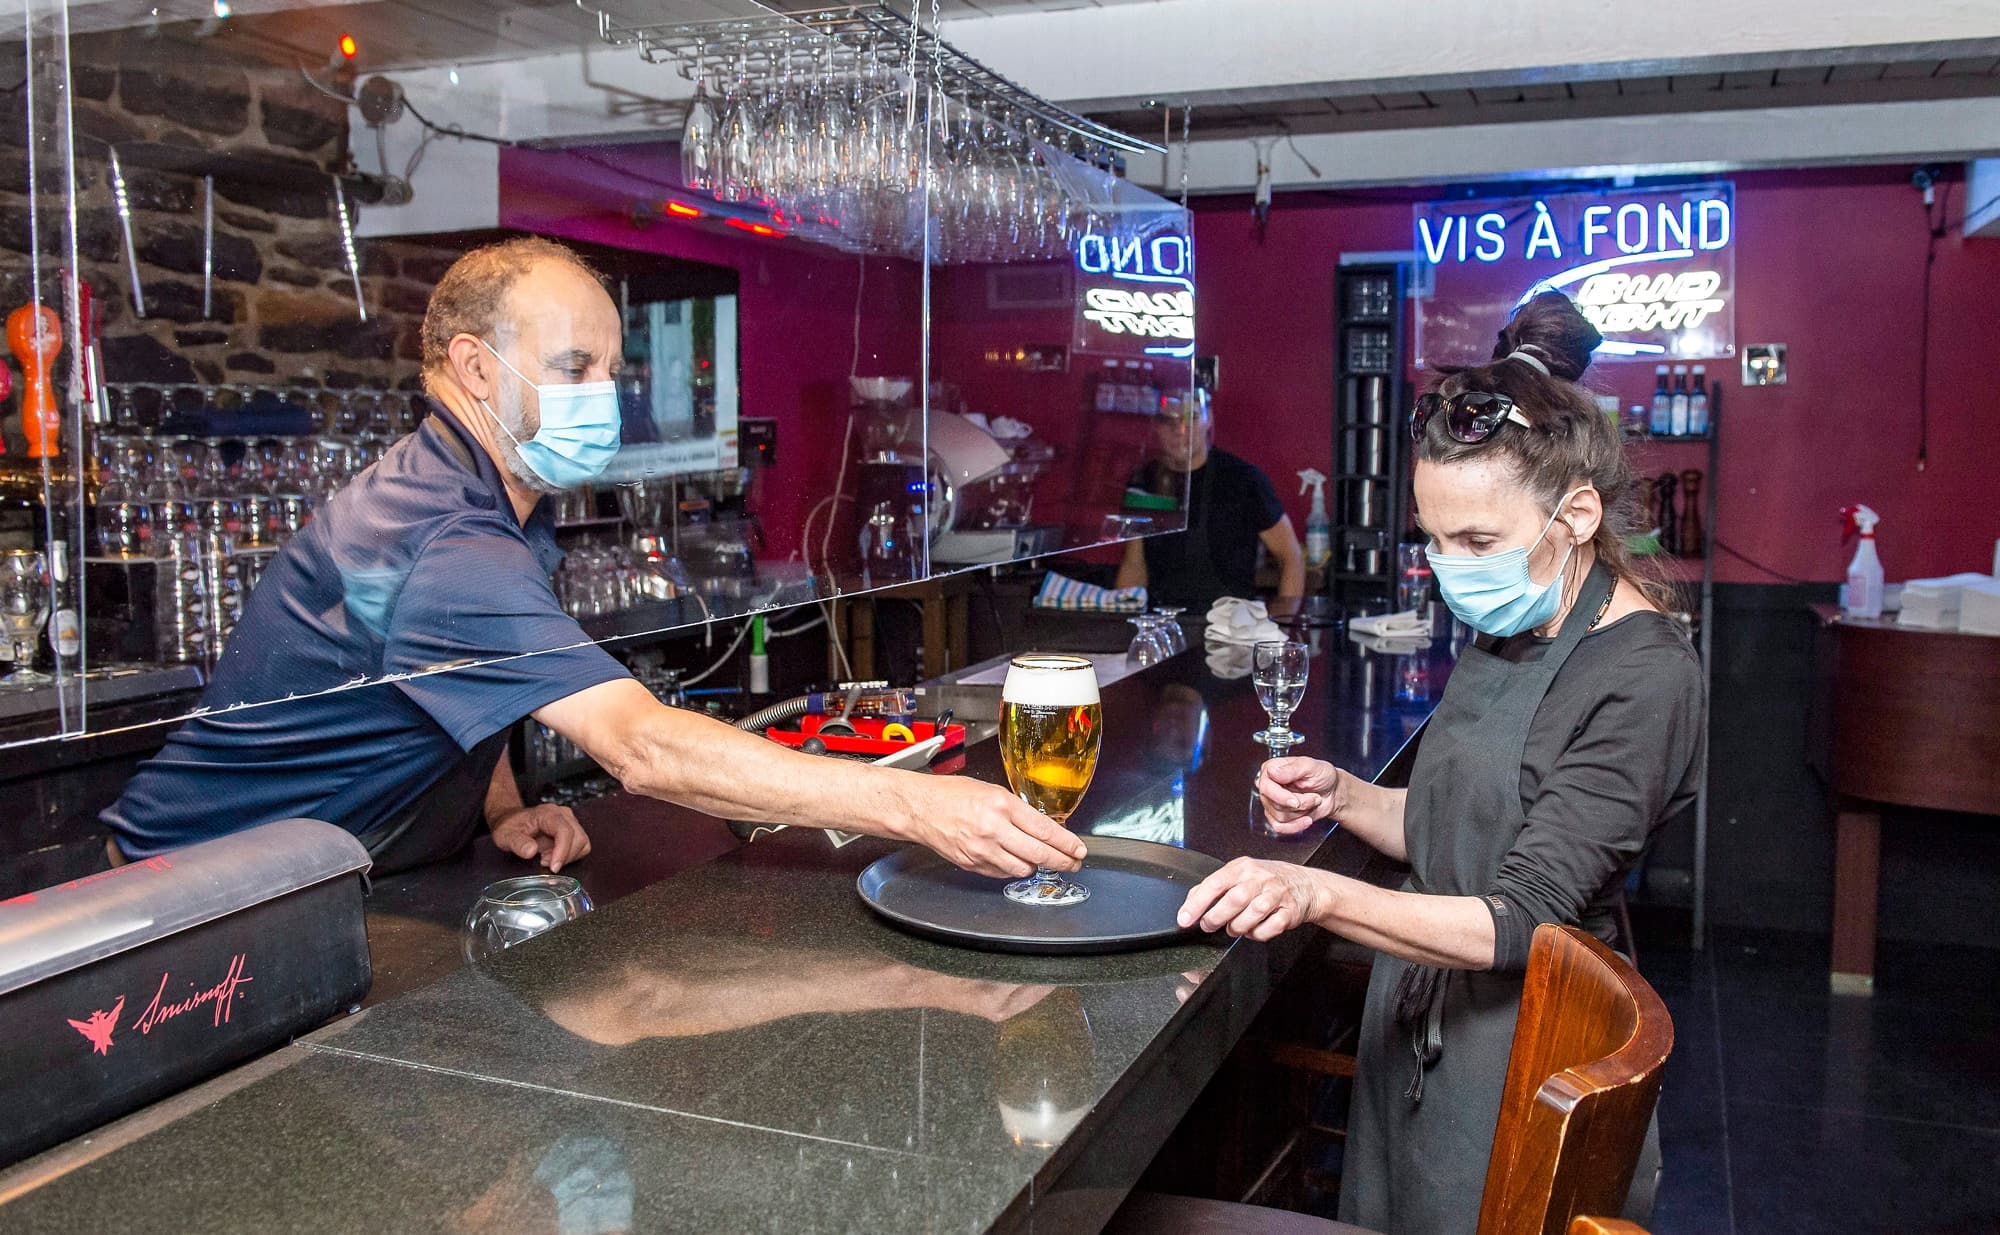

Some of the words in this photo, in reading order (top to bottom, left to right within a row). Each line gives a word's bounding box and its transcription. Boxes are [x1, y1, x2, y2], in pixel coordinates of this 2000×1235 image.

[1418, 213, 1506, 265] VIS
[1525, 200, 1562, 260] À
[1583, 199, 1731, 256] FOND
